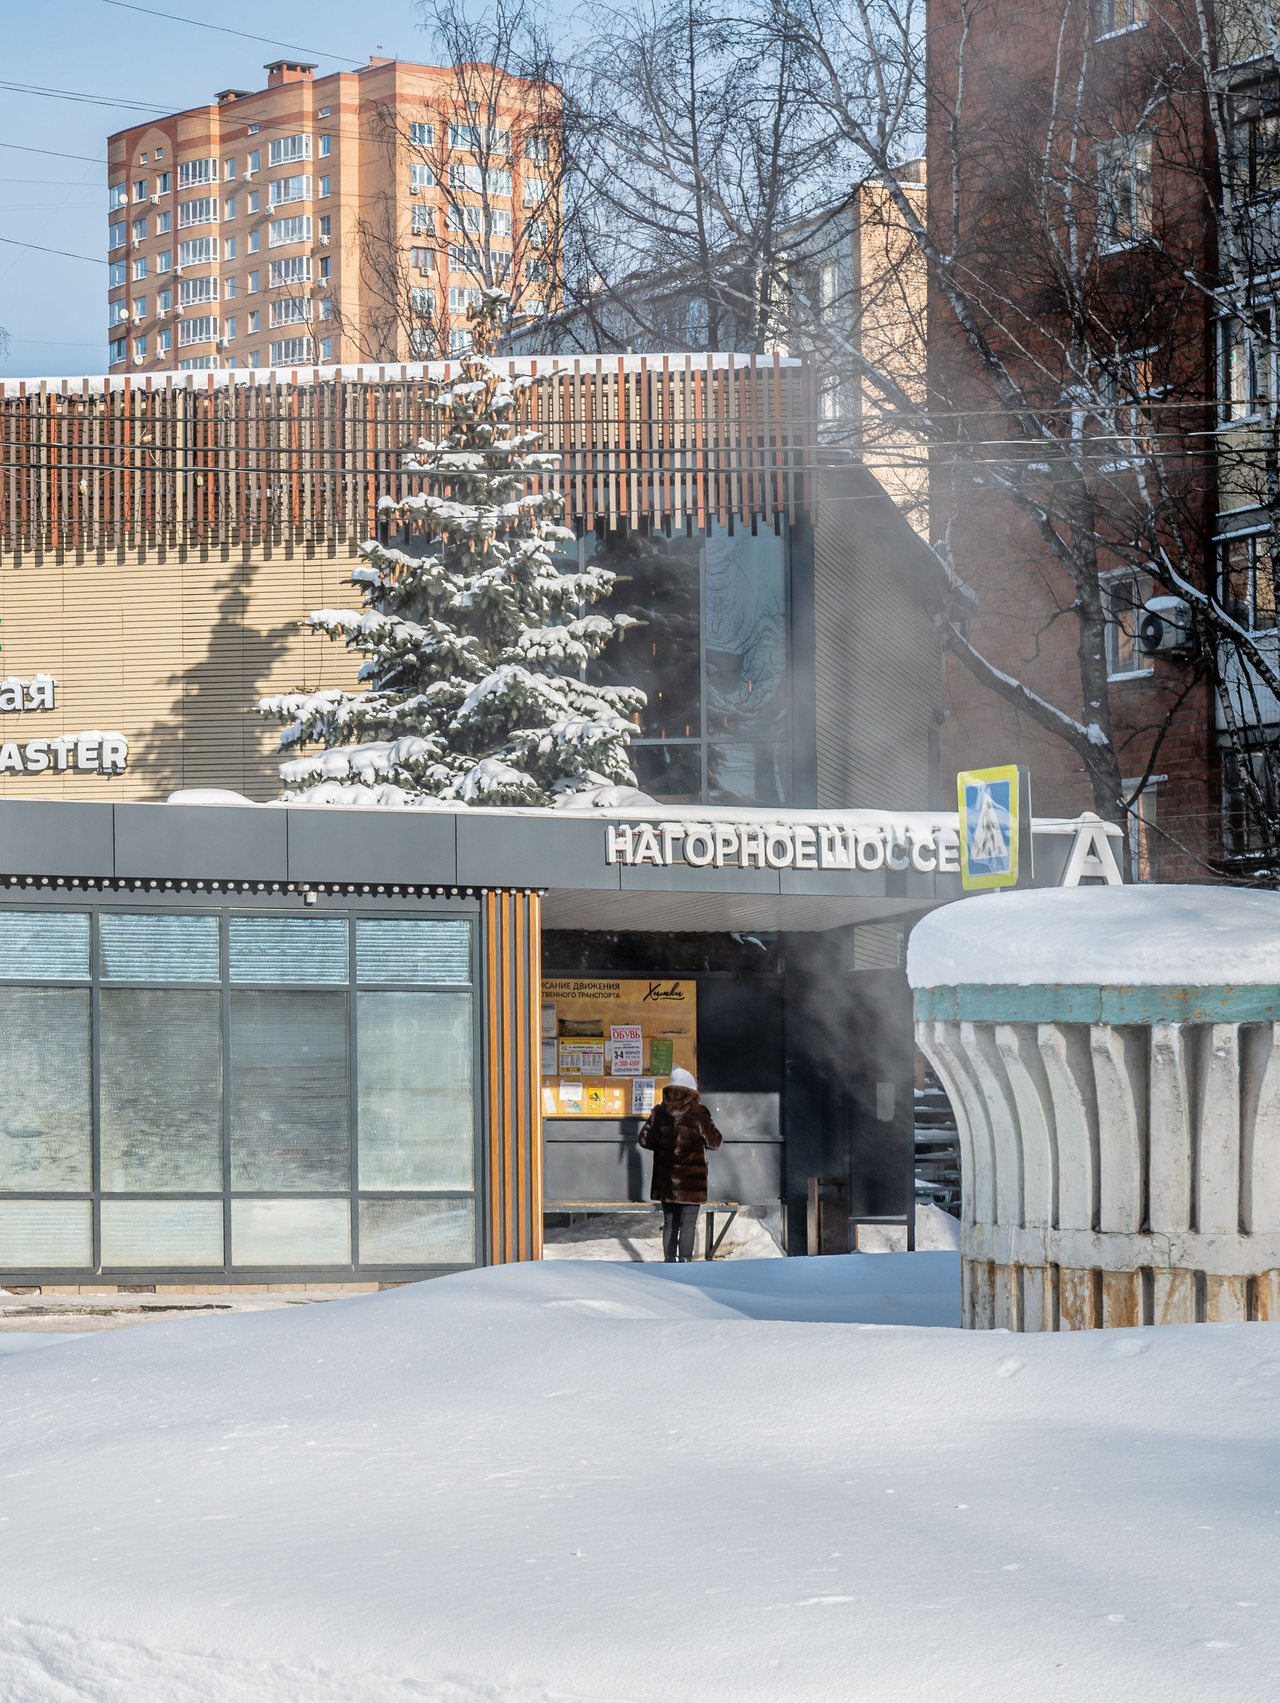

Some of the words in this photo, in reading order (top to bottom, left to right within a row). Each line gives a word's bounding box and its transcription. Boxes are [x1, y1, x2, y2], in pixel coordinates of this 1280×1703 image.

[573, 982, 620, 991] ДВИЖЕНИЯ
[643, 981, 686, 1002] Химки
[612, 1030, 641, 1039] ОБУВЬ
[614, 1050, 624, 1059] 3-4
